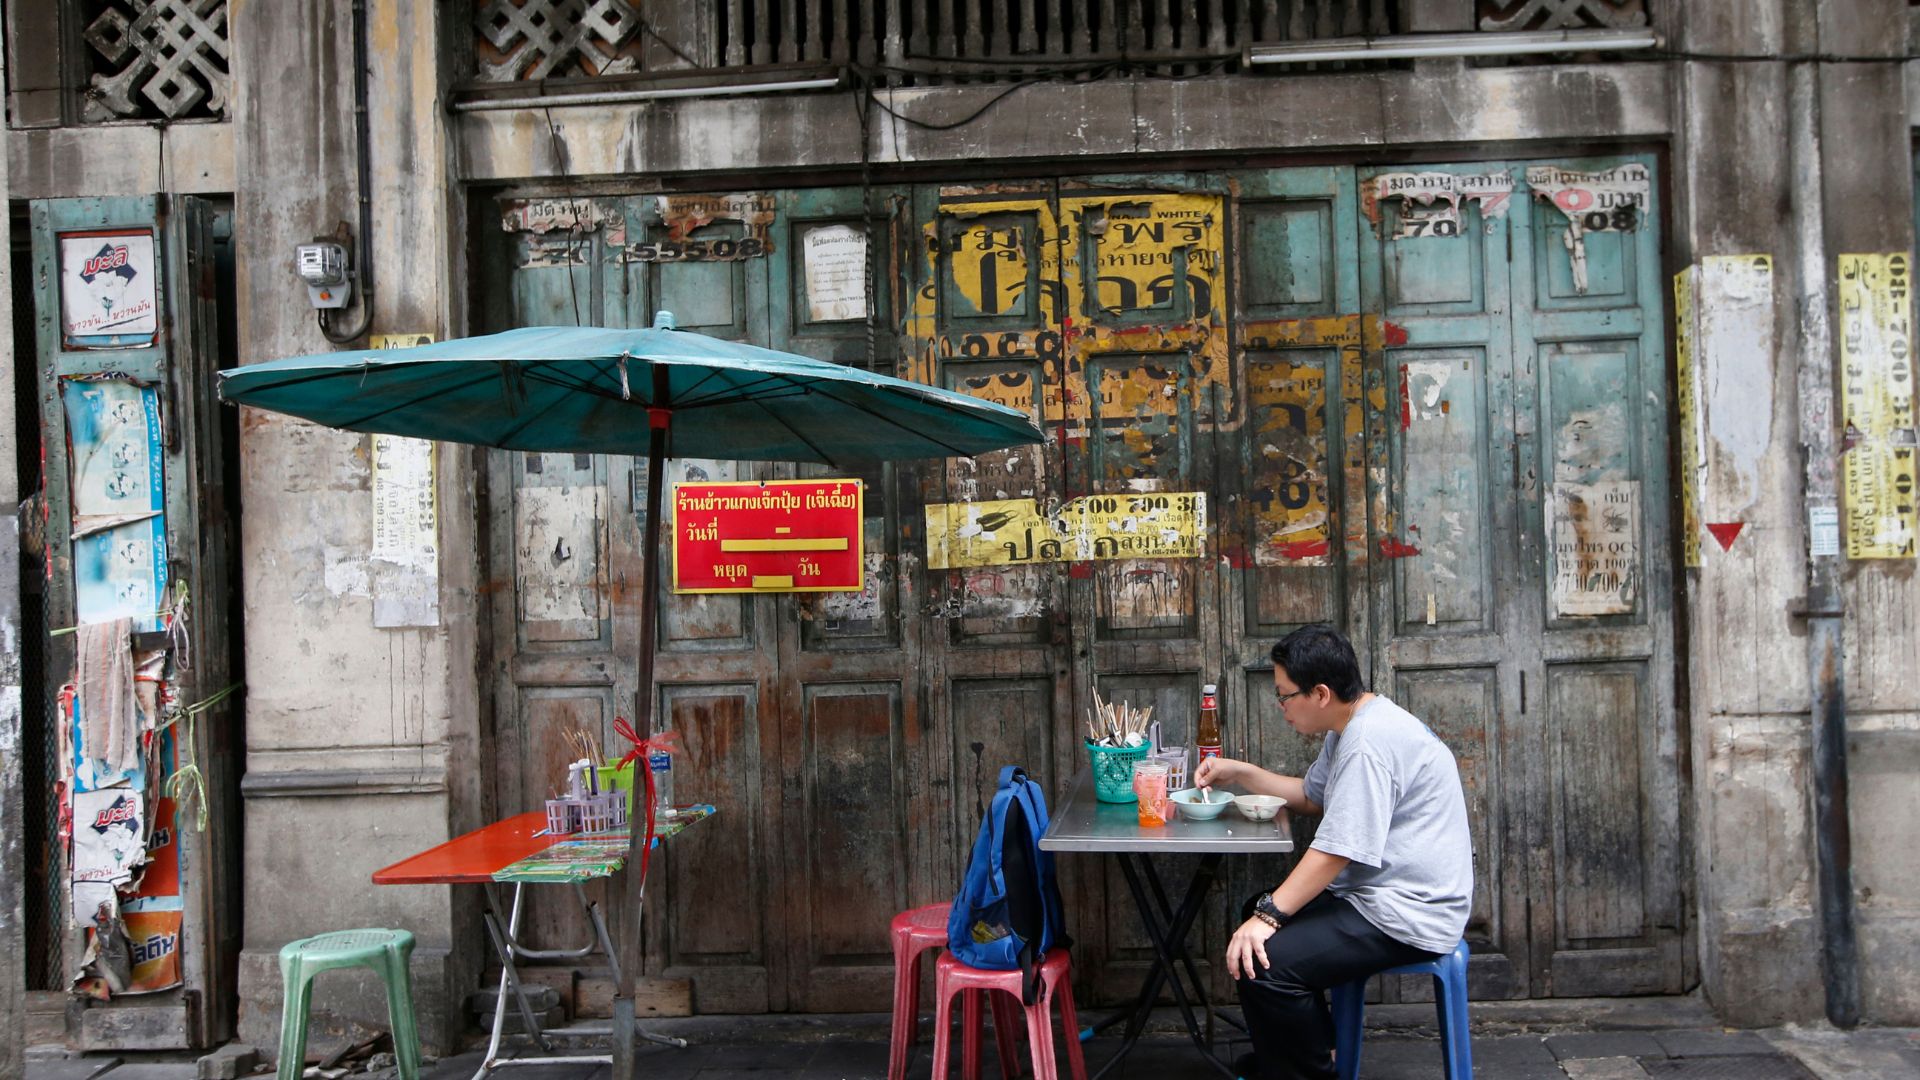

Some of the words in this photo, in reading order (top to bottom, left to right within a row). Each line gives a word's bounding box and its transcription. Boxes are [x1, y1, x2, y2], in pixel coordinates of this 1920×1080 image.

[1157, 211, 1201, 219] WHITE
[83, 245, 128, 275] มะลิ
[1889, 255, 1909, 383] 08-700
[678, 488, 801, 514] ร้านข้าวแกงเจ๊กปุ้ย
[686, 517, 718, 541] วันที่
[1003, 528, 1119, 561] ปลก
[1120, 533, 1206, 556] สมุนพร
[713, 563, 748, 582] หยุด
[797, 557, 821, 576] วัน
[96, 799, 137, 827] มะลิ
